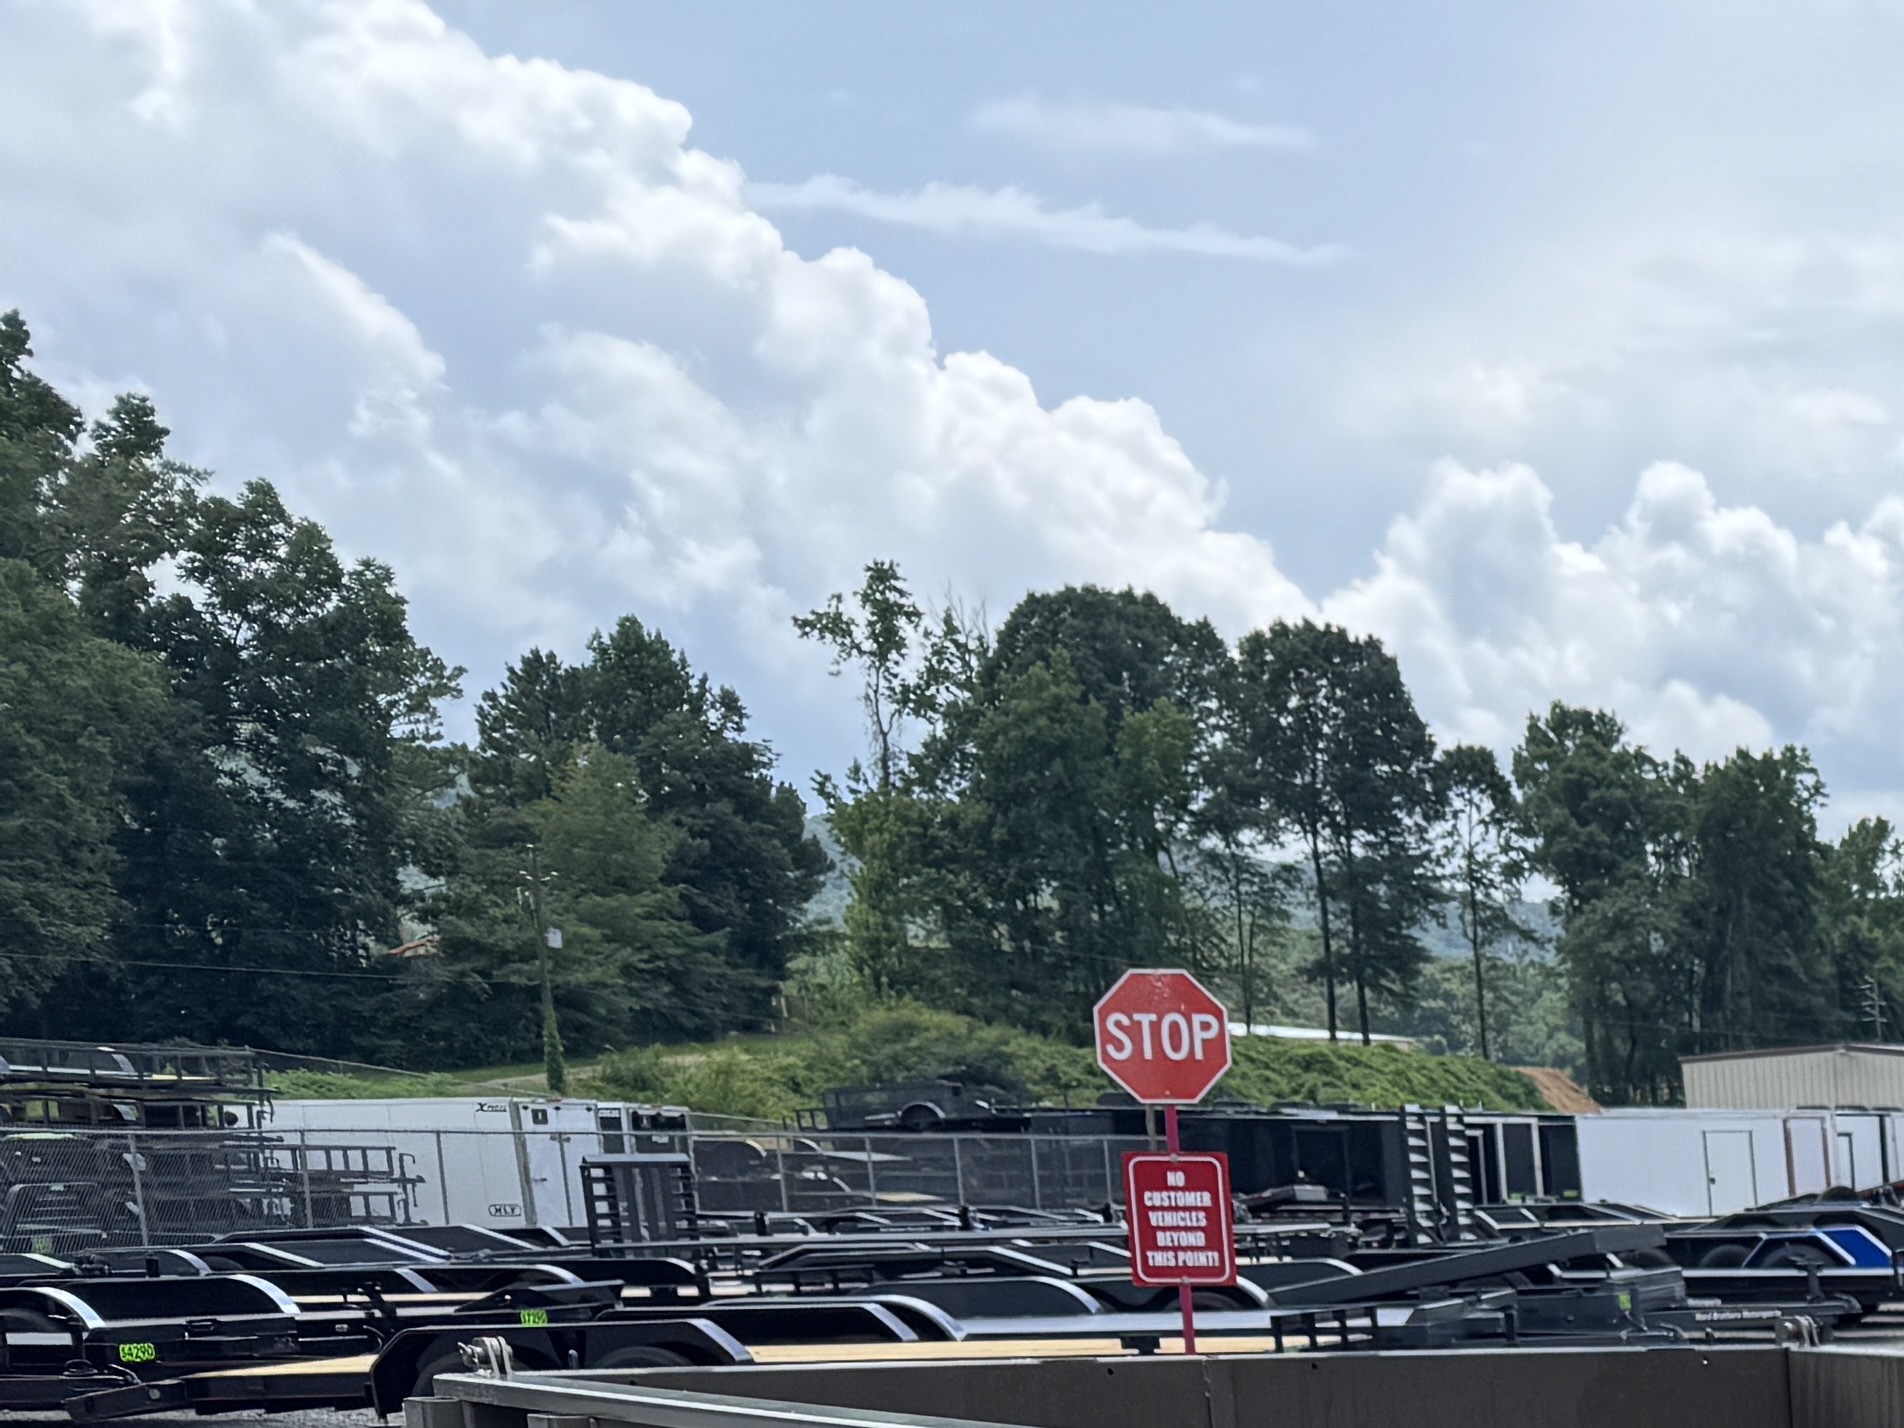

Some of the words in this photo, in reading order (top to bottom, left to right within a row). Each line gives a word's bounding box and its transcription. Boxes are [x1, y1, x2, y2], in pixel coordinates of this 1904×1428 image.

[1105, 1012, 1220, 1061] STOP
[1166, 1171, 1185, 1187] NO
[1143, 1191, 1212, 1207] CUSTOMER
[1148, 1211, 1207, 1227] VEHICLES
[1156, 1231, 1206, 1247] BEYOND
[1146, 1251, 1176, 1267] THIS
[1177, 1251, 1219, 1267] POINT!
